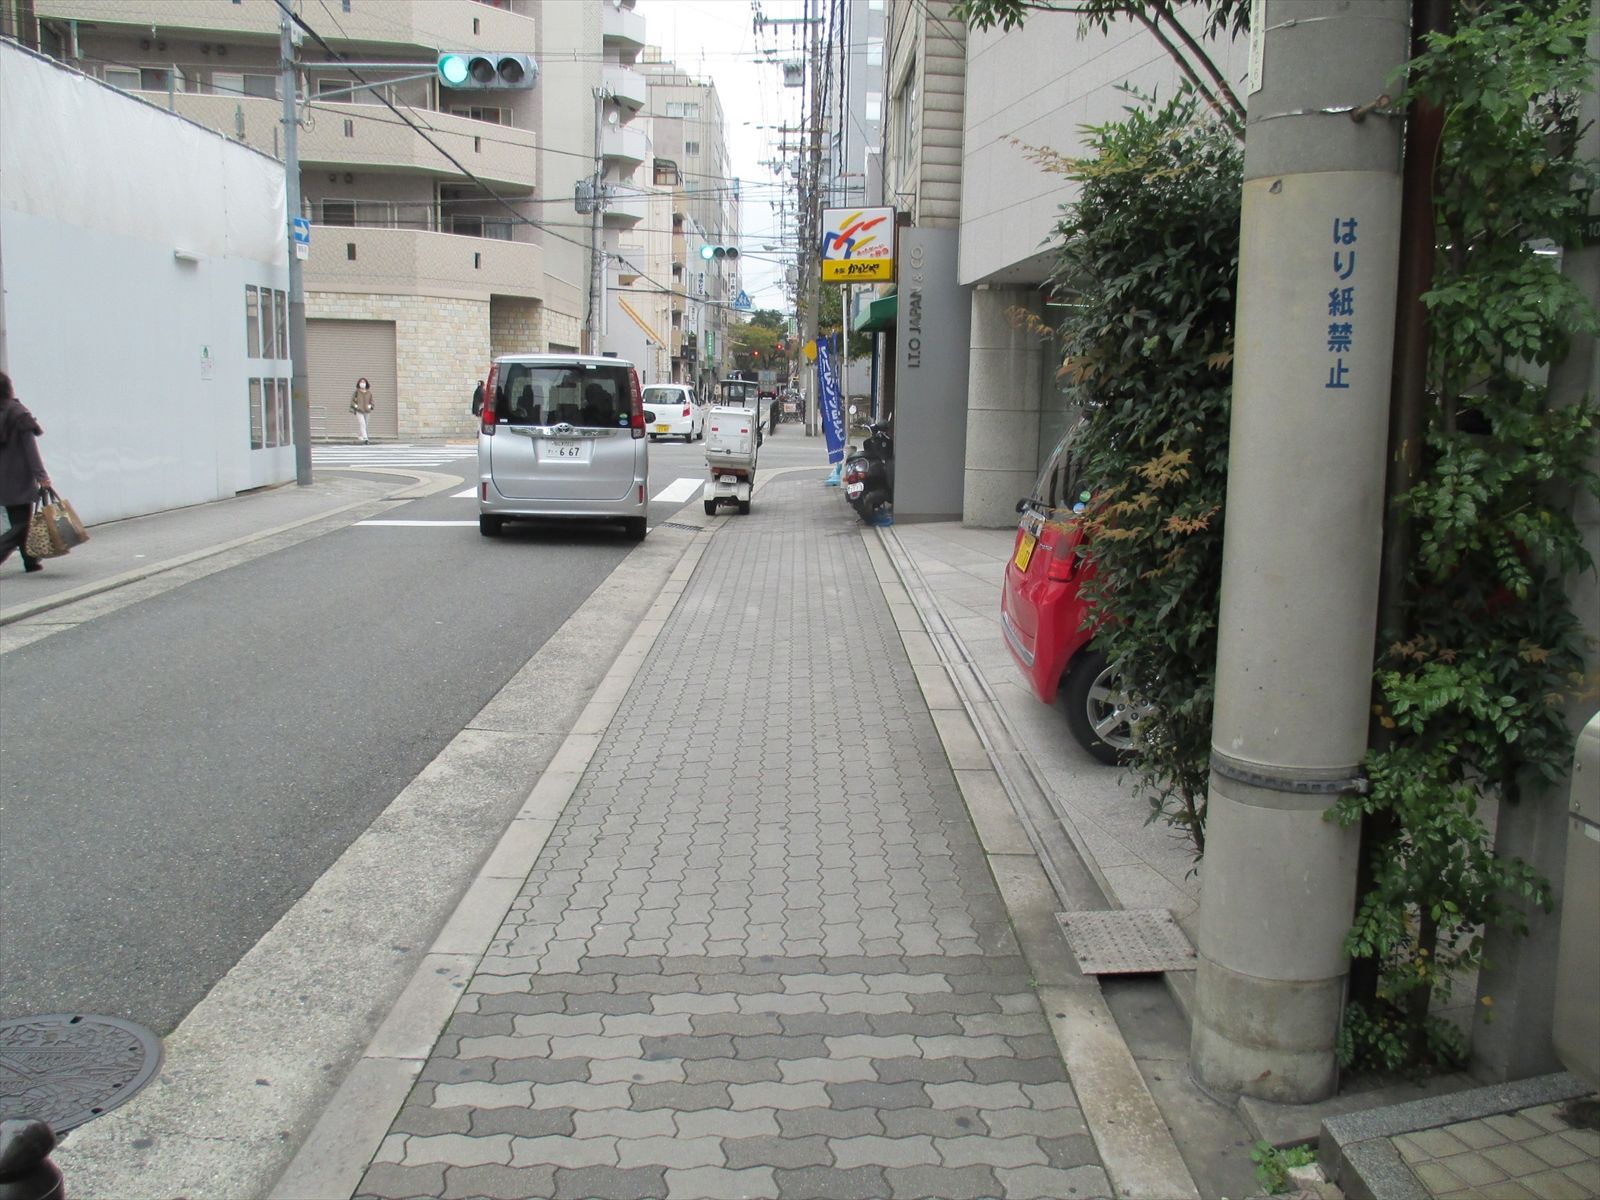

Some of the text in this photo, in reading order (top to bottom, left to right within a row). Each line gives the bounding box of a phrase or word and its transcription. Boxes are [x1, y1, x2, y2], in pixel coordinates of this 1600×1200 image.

[909, 288, 923, 335] JAPAN
[1325, 217, 1358, 389] はり紙禁止
